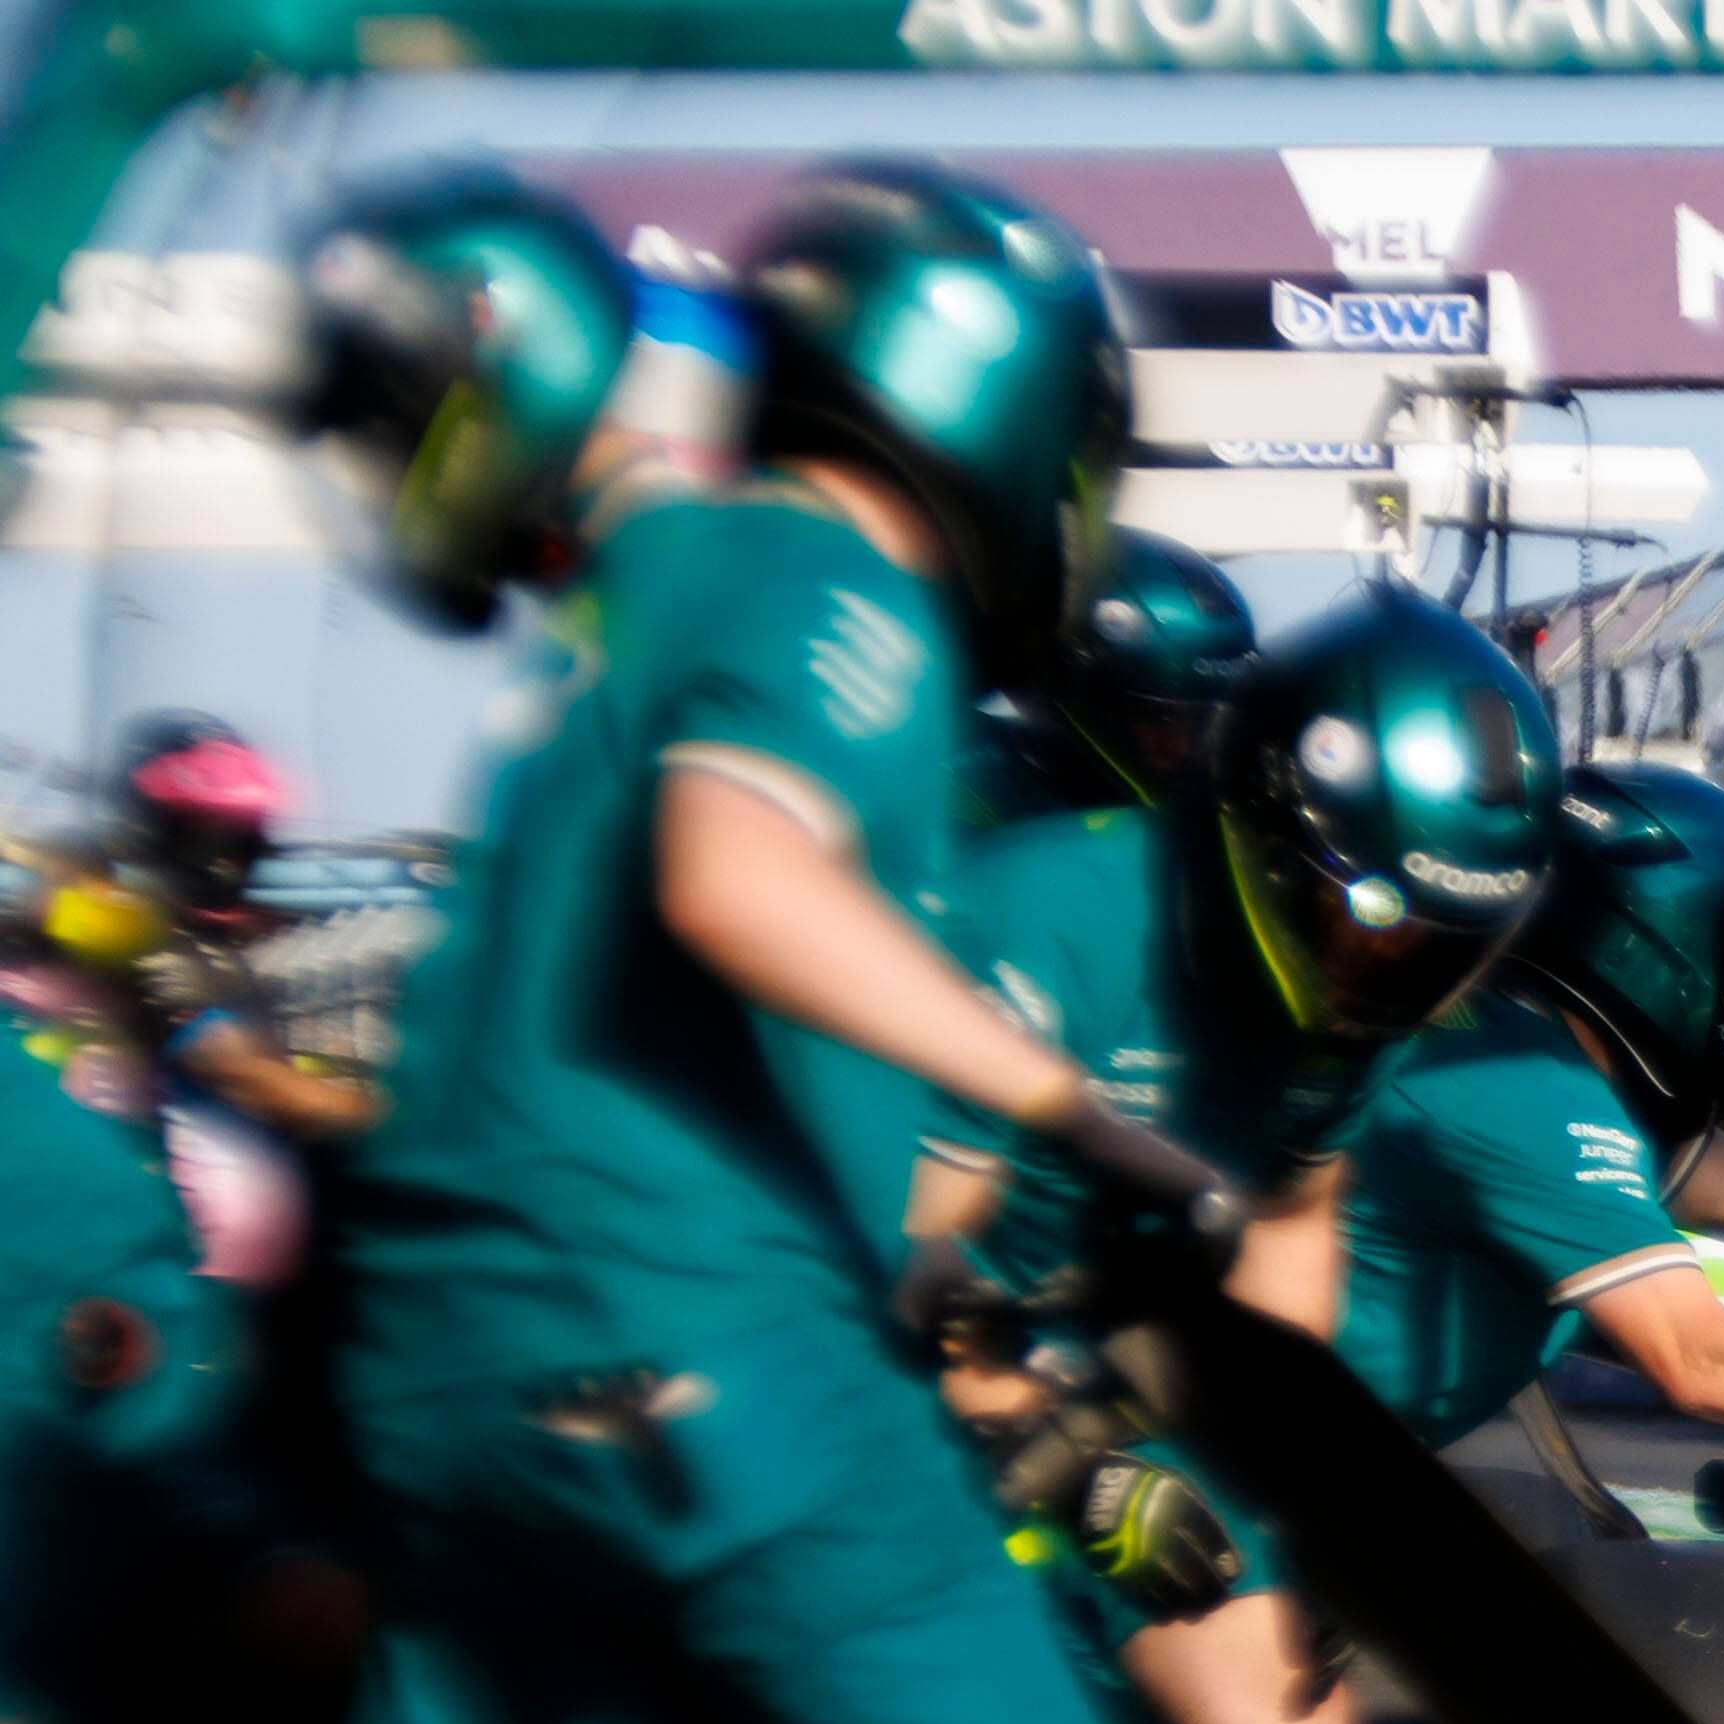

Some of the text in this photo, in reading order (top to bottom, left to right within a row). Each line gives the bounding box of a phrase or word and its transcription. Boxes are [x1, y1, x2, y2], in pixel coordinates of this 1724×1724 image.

[1325, 219, 1443, 263] MEL
[1336, 297, 1475, 342] BWT
[1402, 851, 1529, 896] aramco
